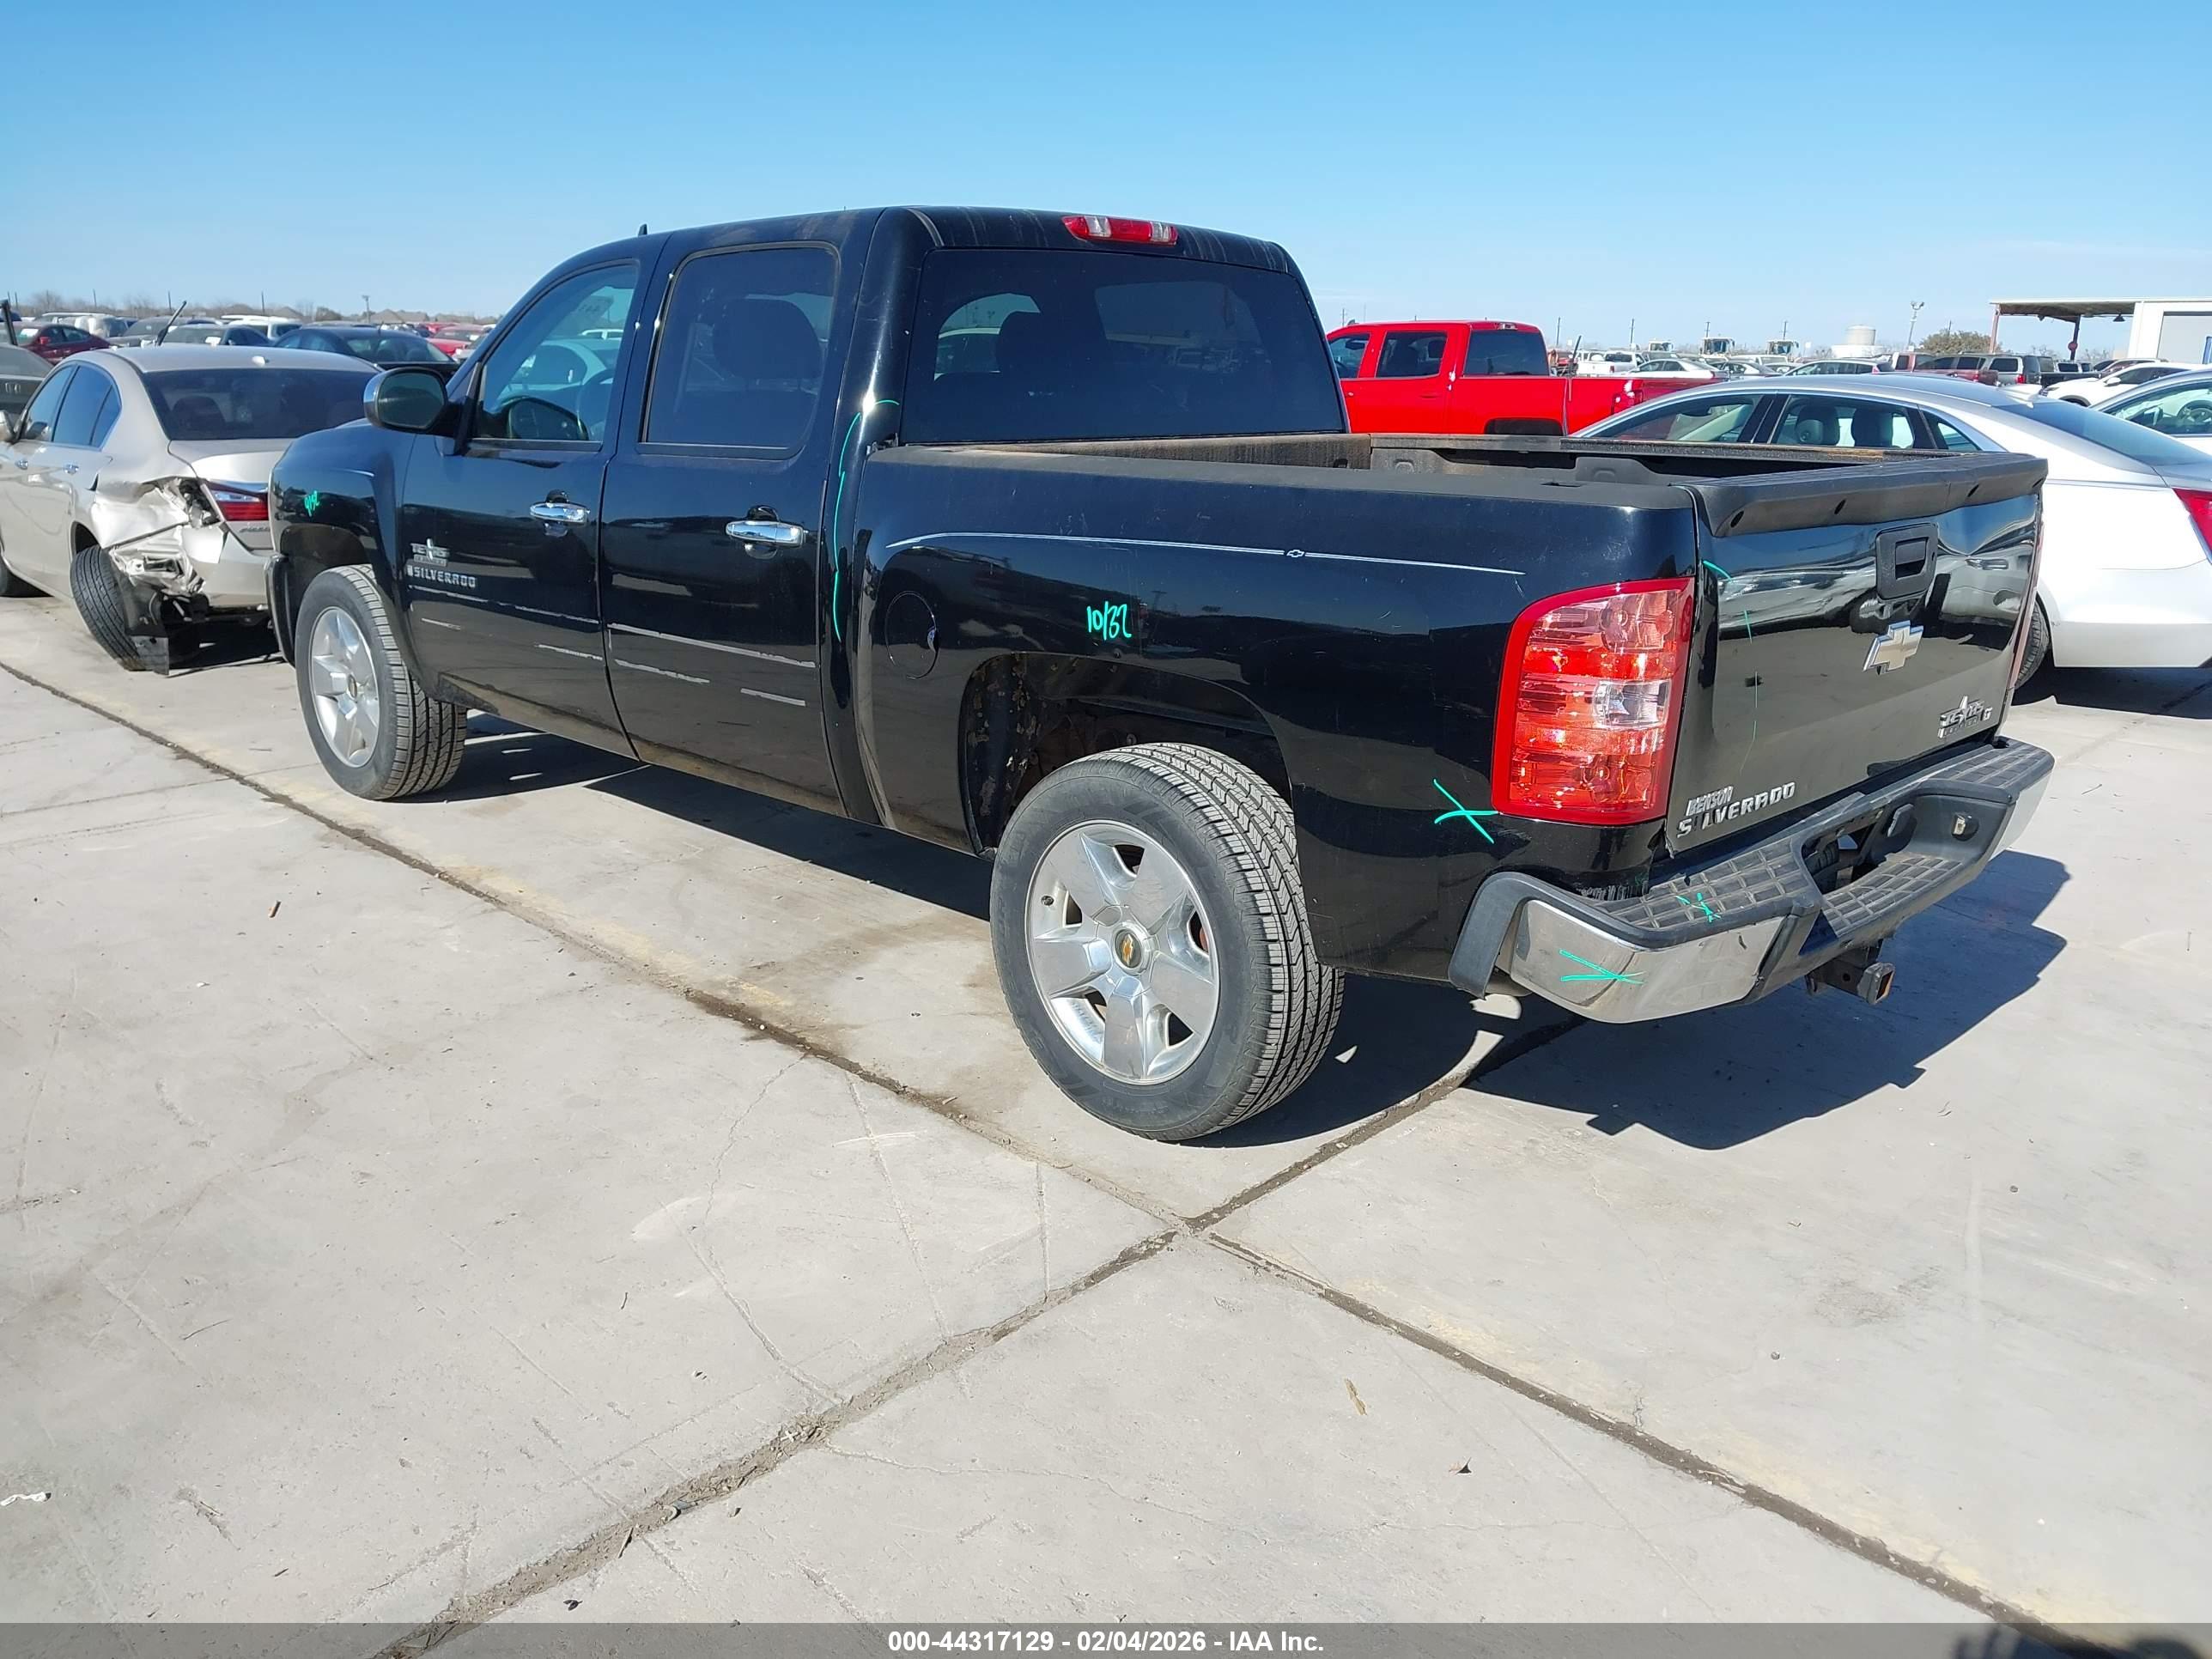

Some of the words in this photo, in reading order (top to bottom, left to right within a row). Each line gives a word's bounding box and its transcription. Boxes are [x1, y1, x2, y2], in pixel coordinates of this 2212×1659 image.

[414, 567, 476, 588] SILVERADO
[1677, 782, 1796, 838] SILVERADO
[1686, 786, 1734, 817] BENSON
